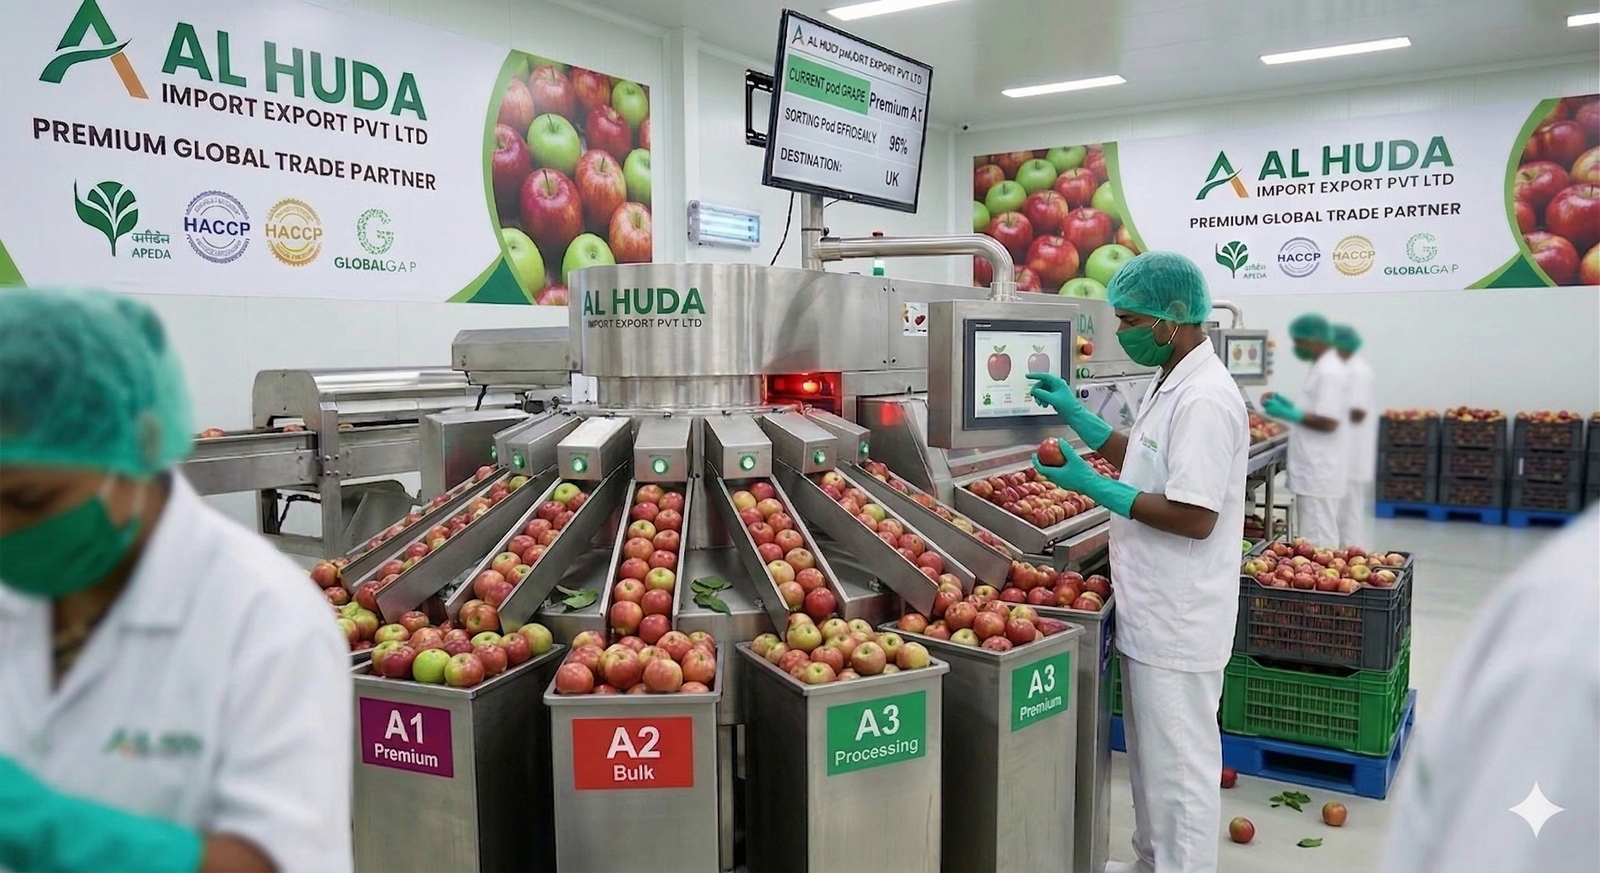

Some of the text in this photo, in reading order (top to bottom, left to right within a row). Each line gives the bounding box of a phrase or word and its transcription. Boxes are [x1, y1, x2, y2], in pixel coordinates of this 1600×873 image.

[162, 22, 427, 121] AL HUDA
[870, 58, 896, 75] EXPORT
[897, 68, 910, 80] PVT
[789, 67, 866, 103] CURRENT pod GRAPE
[162, 83, 428, 146] IMPORT EXPORT PVT LTD
[869, 92, 909, 119] Premium
[785, 107, 819, 128] SORTING
[820, 118, 836, 133] Pod
[32, 117, 437, 191] PREMIUM GLOBAL TRADE PARTNER
[889, 135, 908, 155] 96%
[780, 147, 842, 172] DESTINATION:
[1258, 136, 1454, 181] AL HUDA
[885, 170, 900, 187] UK
[1257, 173, 1454, 198] IMPORT EXPORT PVT LTD
[184, 216, 251, 237] HACCP
[1190, 203, 1462, 229] PREMIUM GLOBAL TRADE PARTNER
[265, 223, 323, 242] HACCP
[131, 247, 172, 260] APEDA
[1277, 252, 1321, 263] HACCP
[1332, 250, 1376, 261] HACCP
[583, 287, 706, 316] AL HUDA
[616, 318, 655, 328] EXPORT
[657, 318, 680, 328] PVT
[682, 318, 702, 328] LTD
[1027, 664, 1056, 699] A3
[1019, 695, 1062, 721] Premium
[384, 709, 424, 744] A1
[855, 704, 900, 741] A3
[374, 743, 439, 769] Premium
[606, 726, 661, 760] A2
[835, 737, 919, 766] Processing
[613, 764, 655, 782] Bulk
